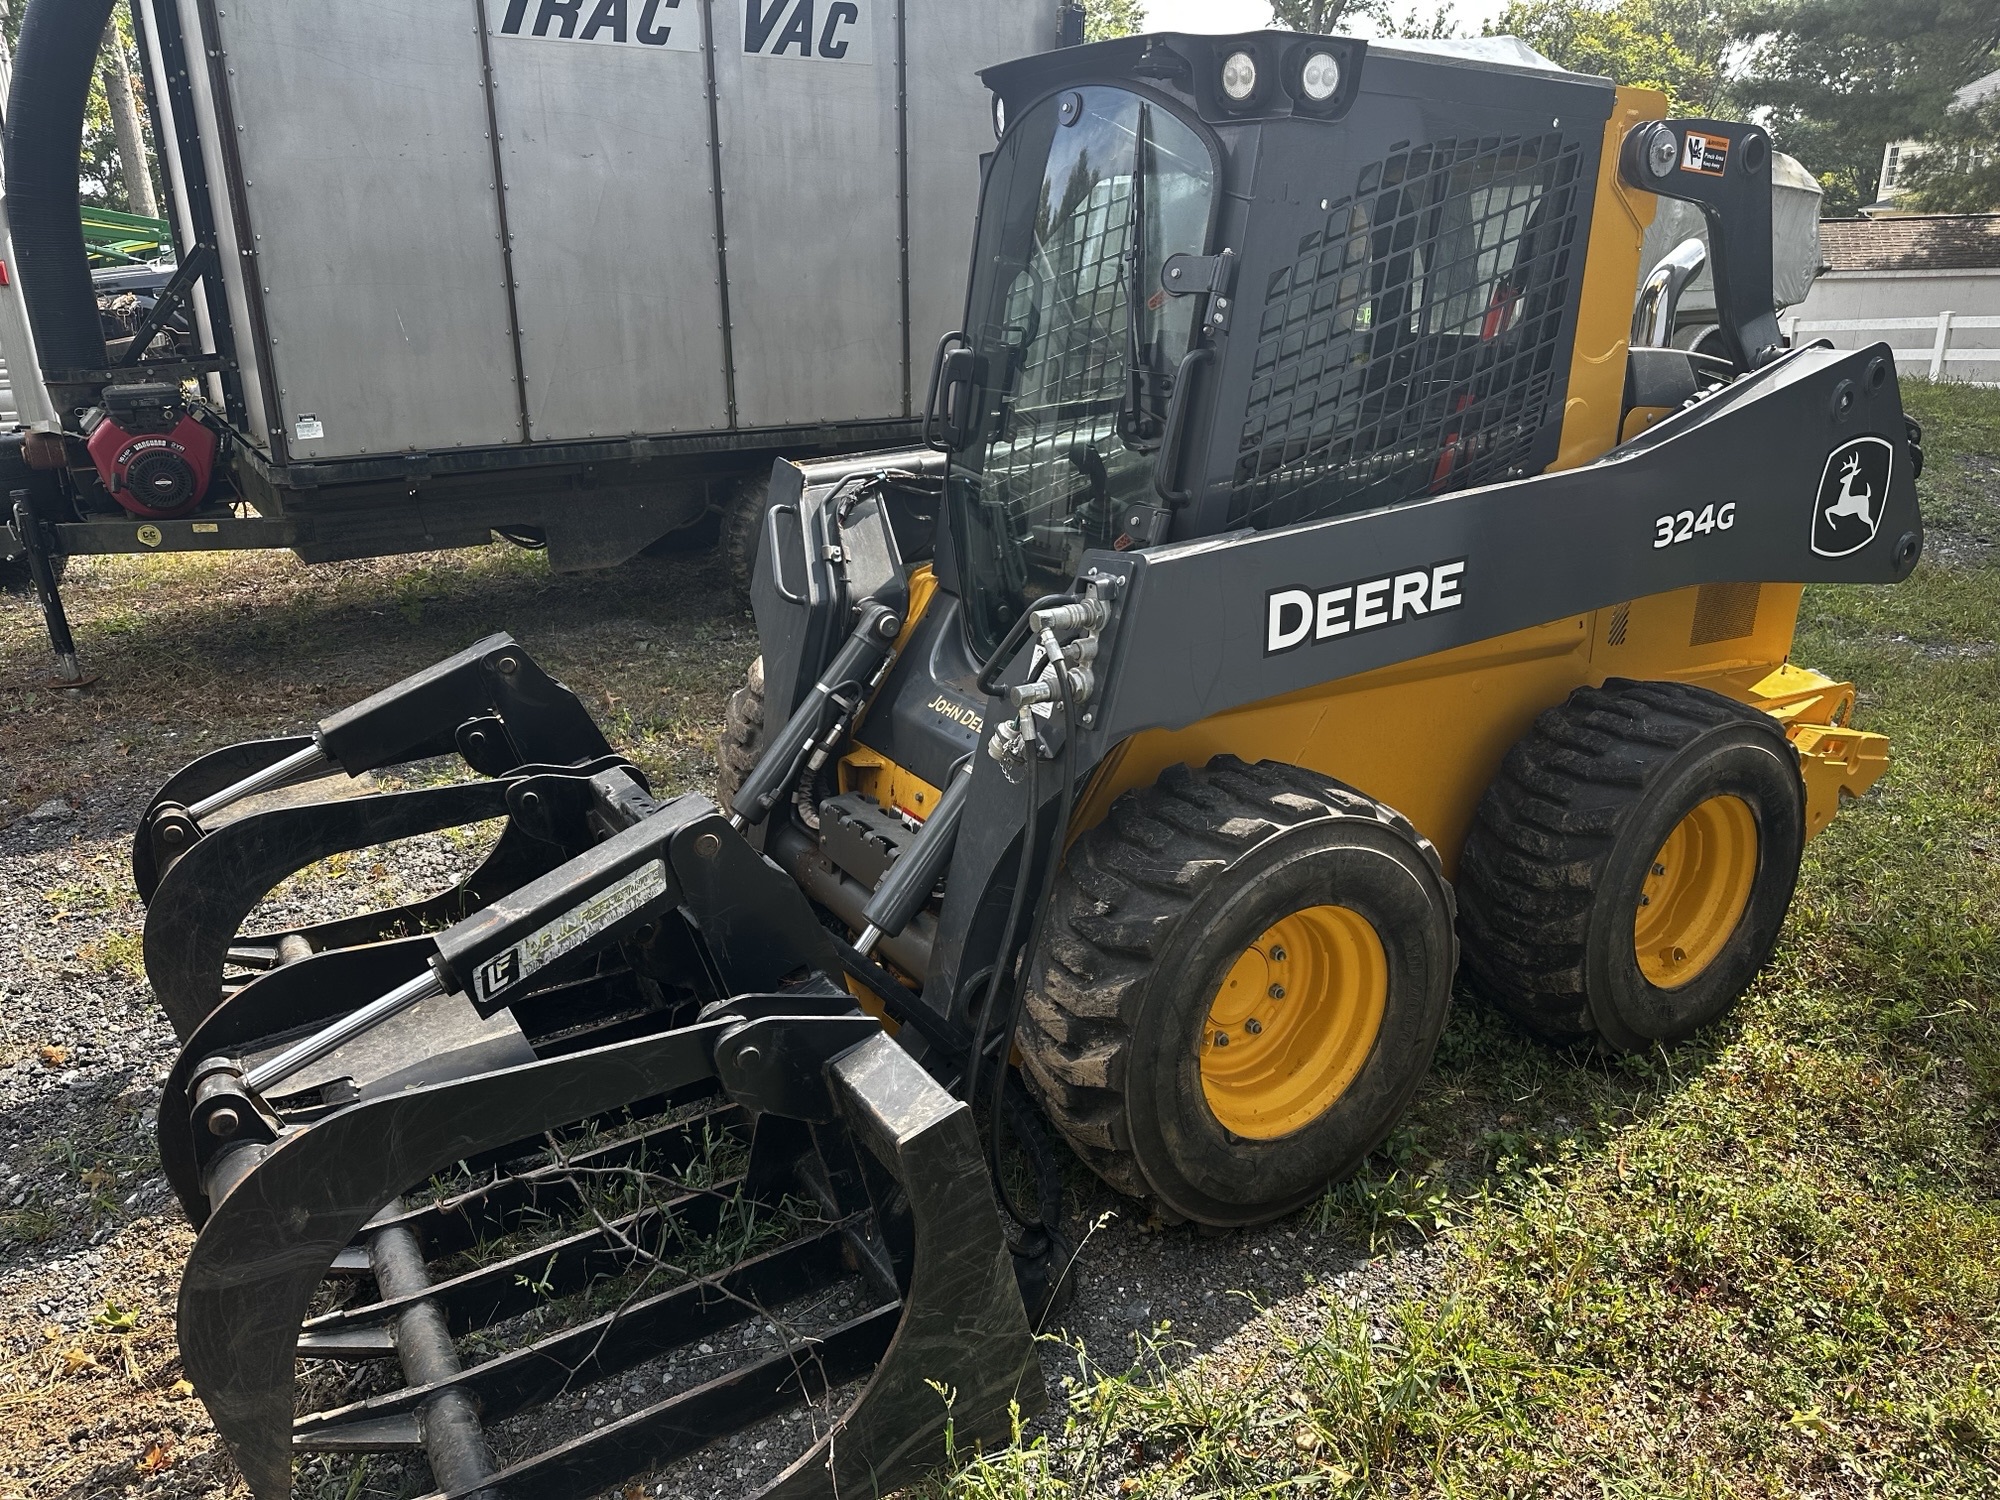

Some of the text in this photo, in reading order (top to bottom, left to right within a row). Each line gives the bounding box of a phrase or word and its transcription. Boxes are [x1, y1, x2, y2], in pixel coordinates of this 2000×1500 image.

[744, 0, 859, 59] VAC
[1653, 502, 1736, 548] 324G
[1268, 561, 1465, 652] DEERE
[927, 695, 964, 720] JOHN
